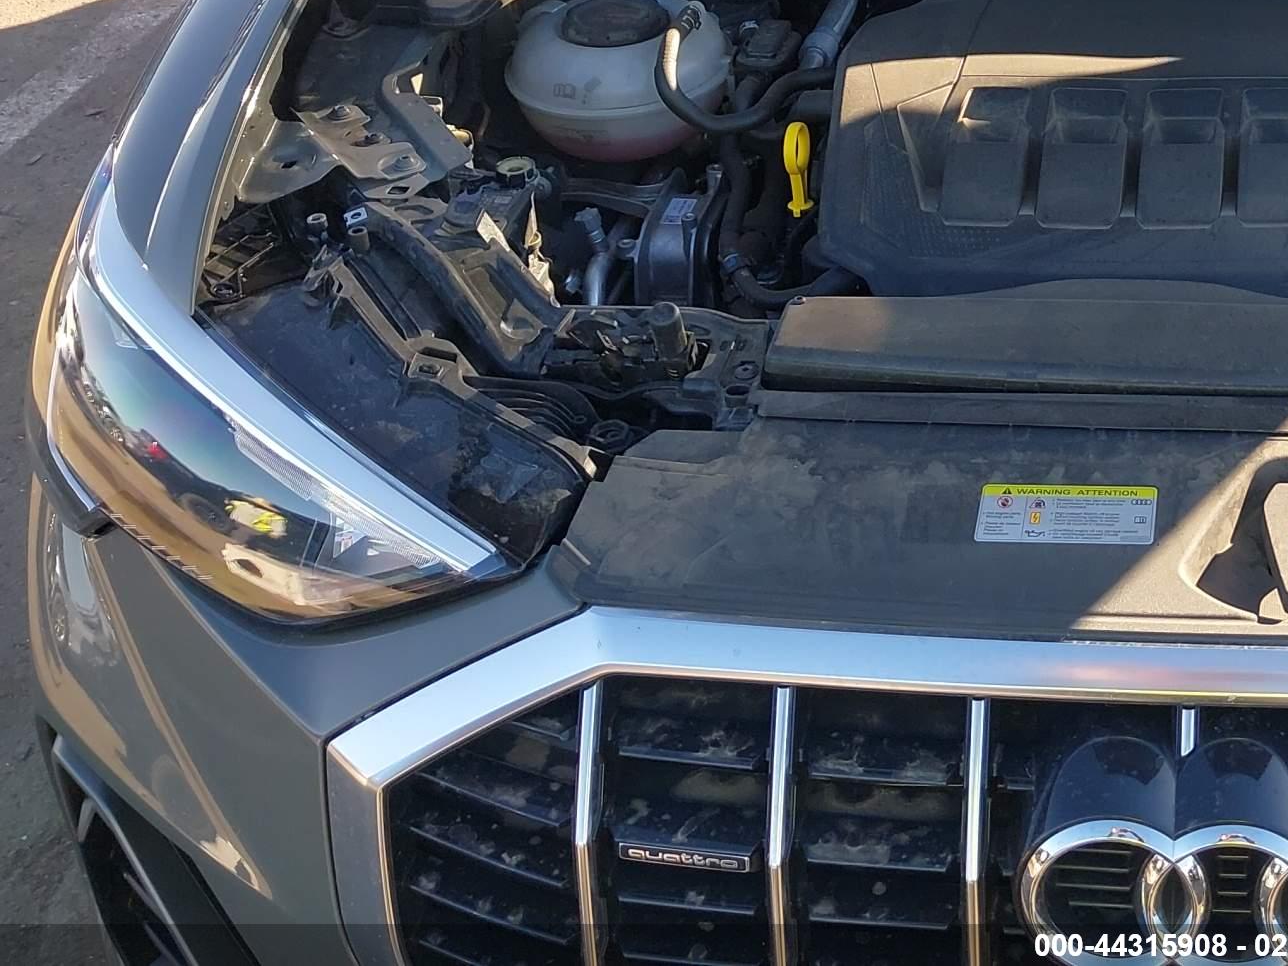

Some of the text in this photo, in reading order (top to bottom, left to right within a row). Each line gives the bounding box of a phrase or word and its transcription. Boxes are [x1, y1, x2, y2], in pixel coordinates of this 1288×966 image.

[1016, 487, 1138, 497] WARNING ATTENTION
[628, 848, 738, 868] quattro
